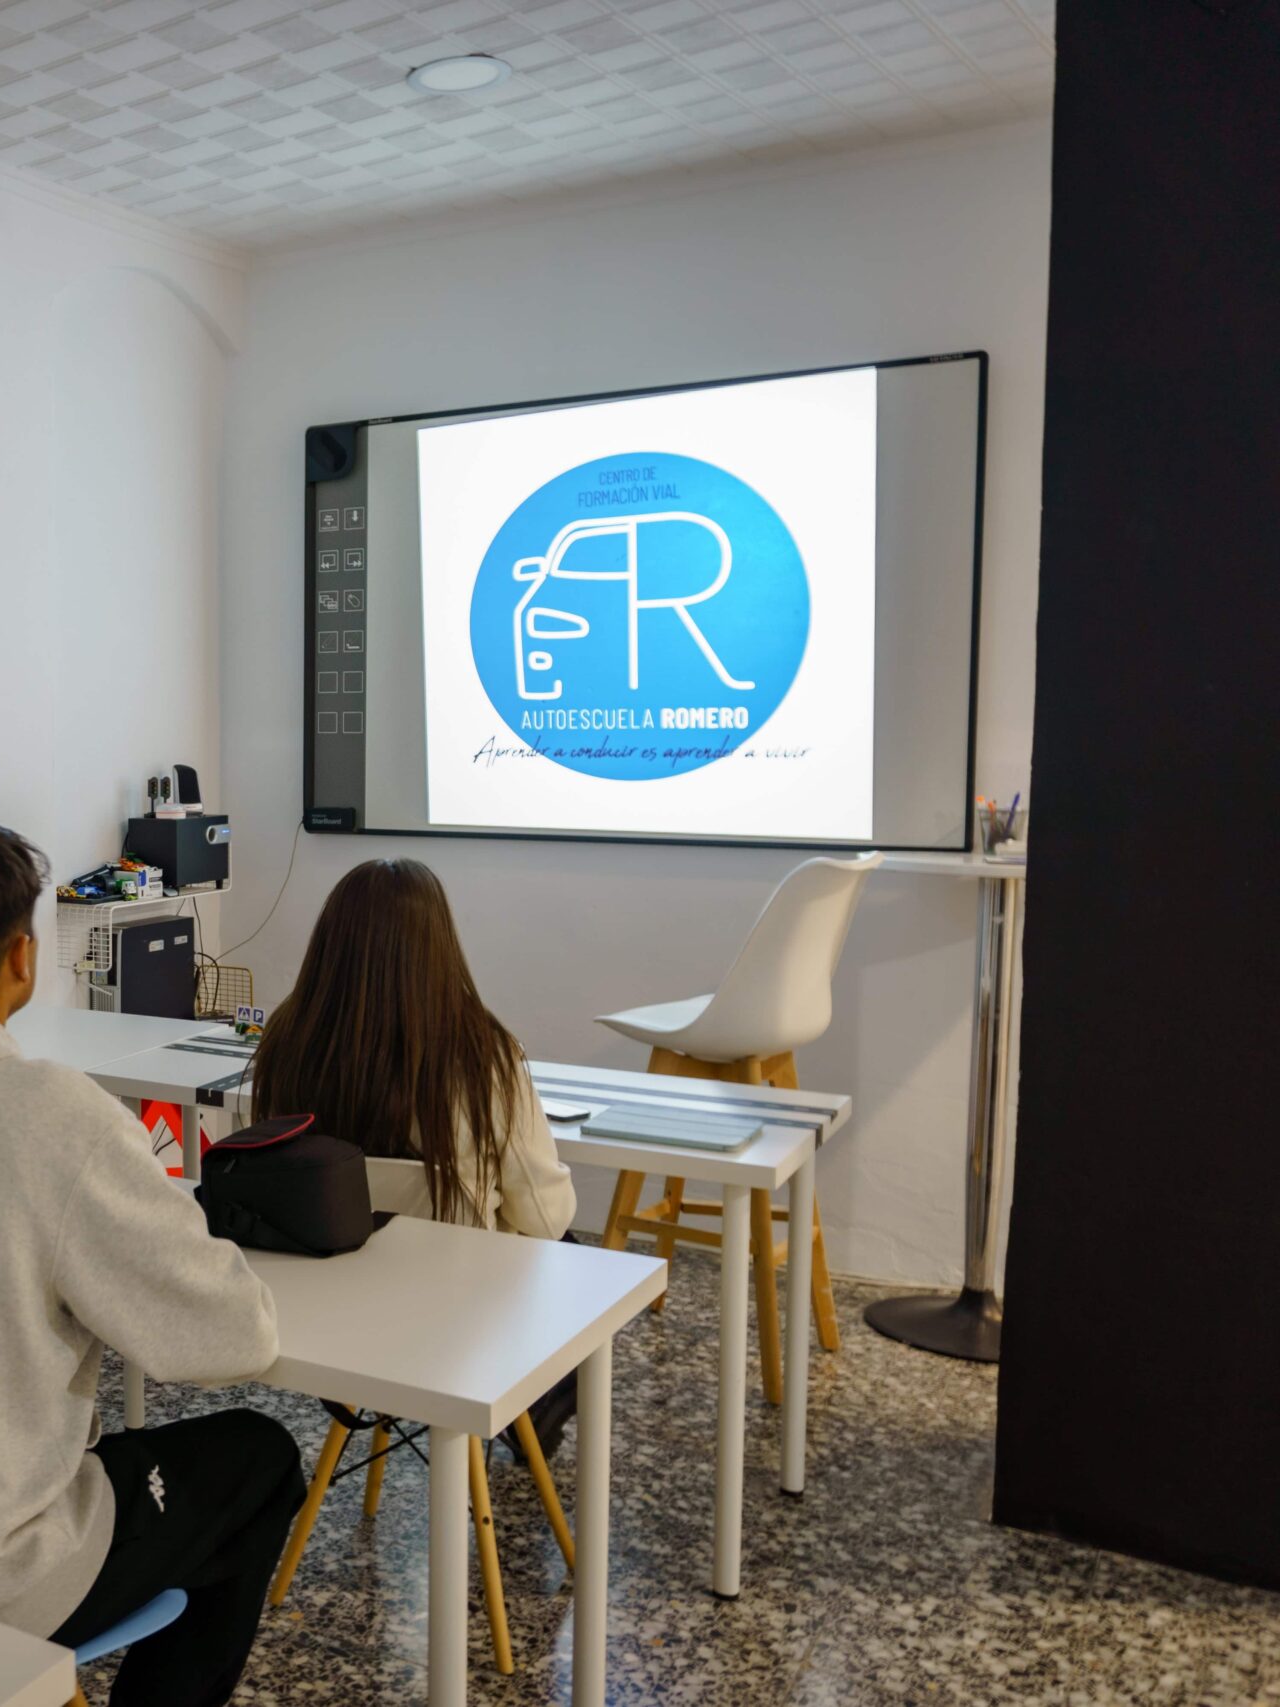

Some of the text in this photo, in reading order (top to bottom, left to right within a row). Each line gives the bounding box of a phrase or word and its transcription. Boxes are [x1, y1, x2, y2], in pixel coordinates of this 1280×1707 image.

[599, 466, 656, 485] CENTRO DE
[577, 483, 681, 508] FORMACIÓN VIAL
[522, 706, 749, 730] AUTOESCUELA ROMERO
[473, 736, 550, 768] Aprender
[553, 749, 565, 758] a
[570, 735, 637, 759] conducir
[641, 748, 657, 761] es
[663, 735, 735, 768] aprender
